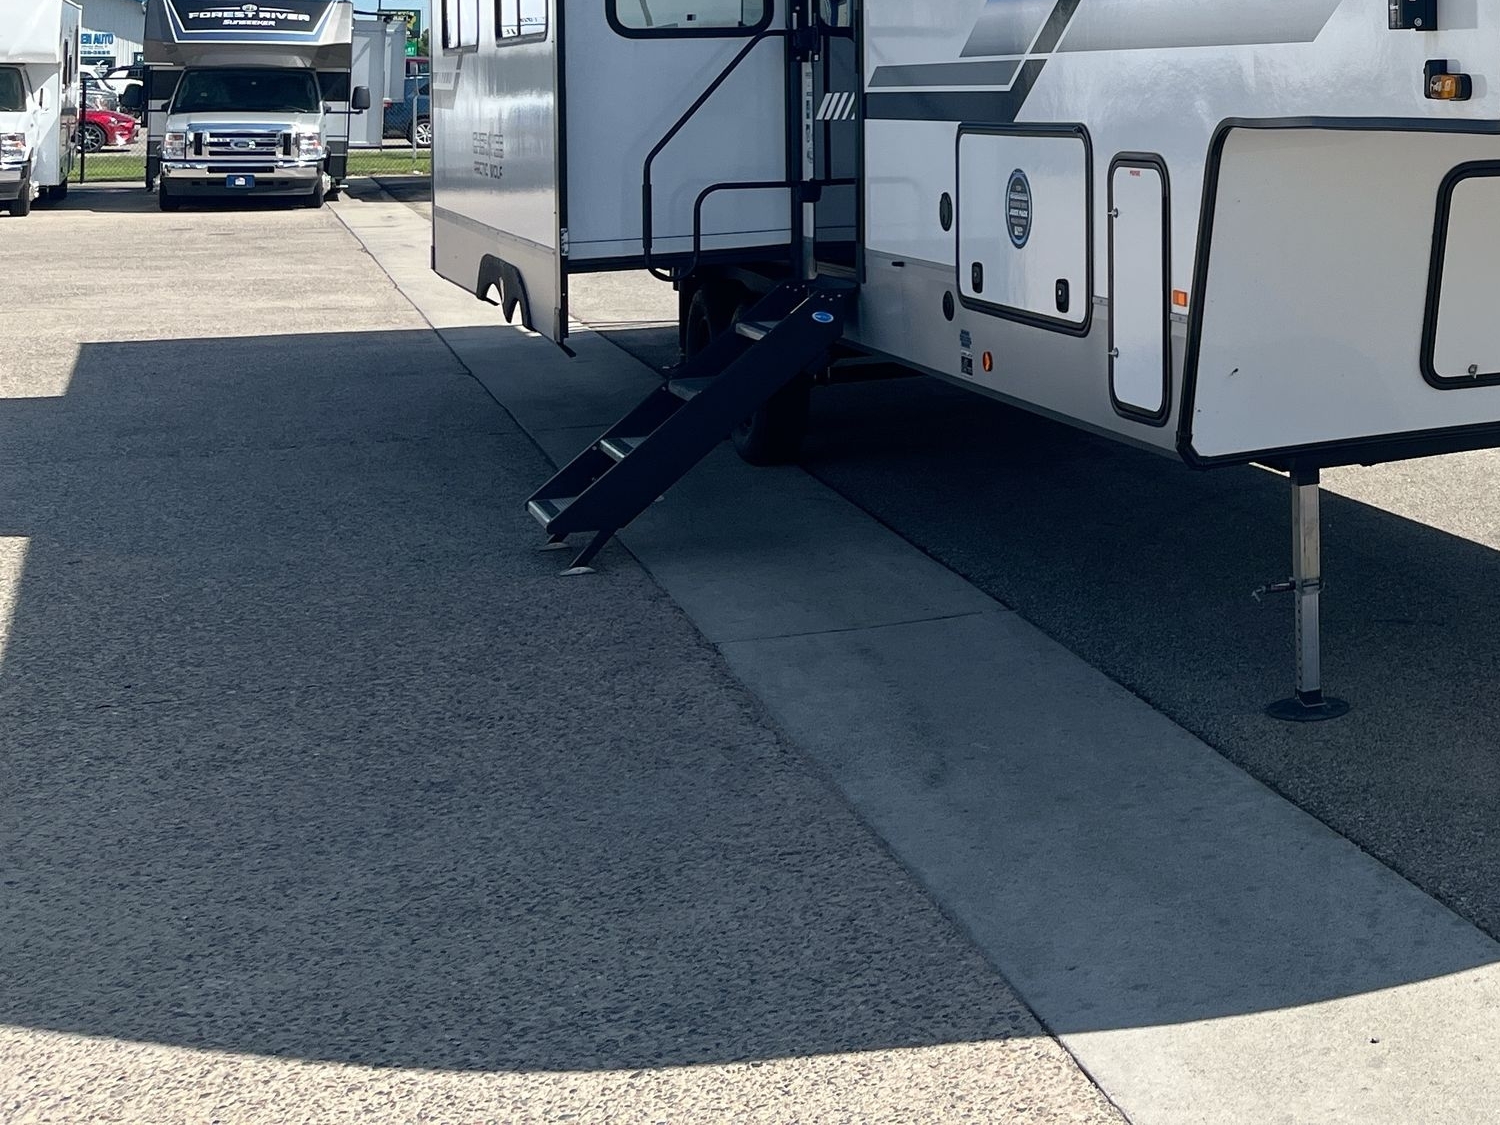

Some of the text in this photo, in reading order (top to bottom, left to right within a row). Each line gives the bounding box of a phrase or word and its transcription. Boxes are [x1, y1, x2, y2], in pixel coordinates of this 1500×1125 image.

[188, 11, 310, 22] FOREST RIVER
[93, 33, 114, 44] AUTO
